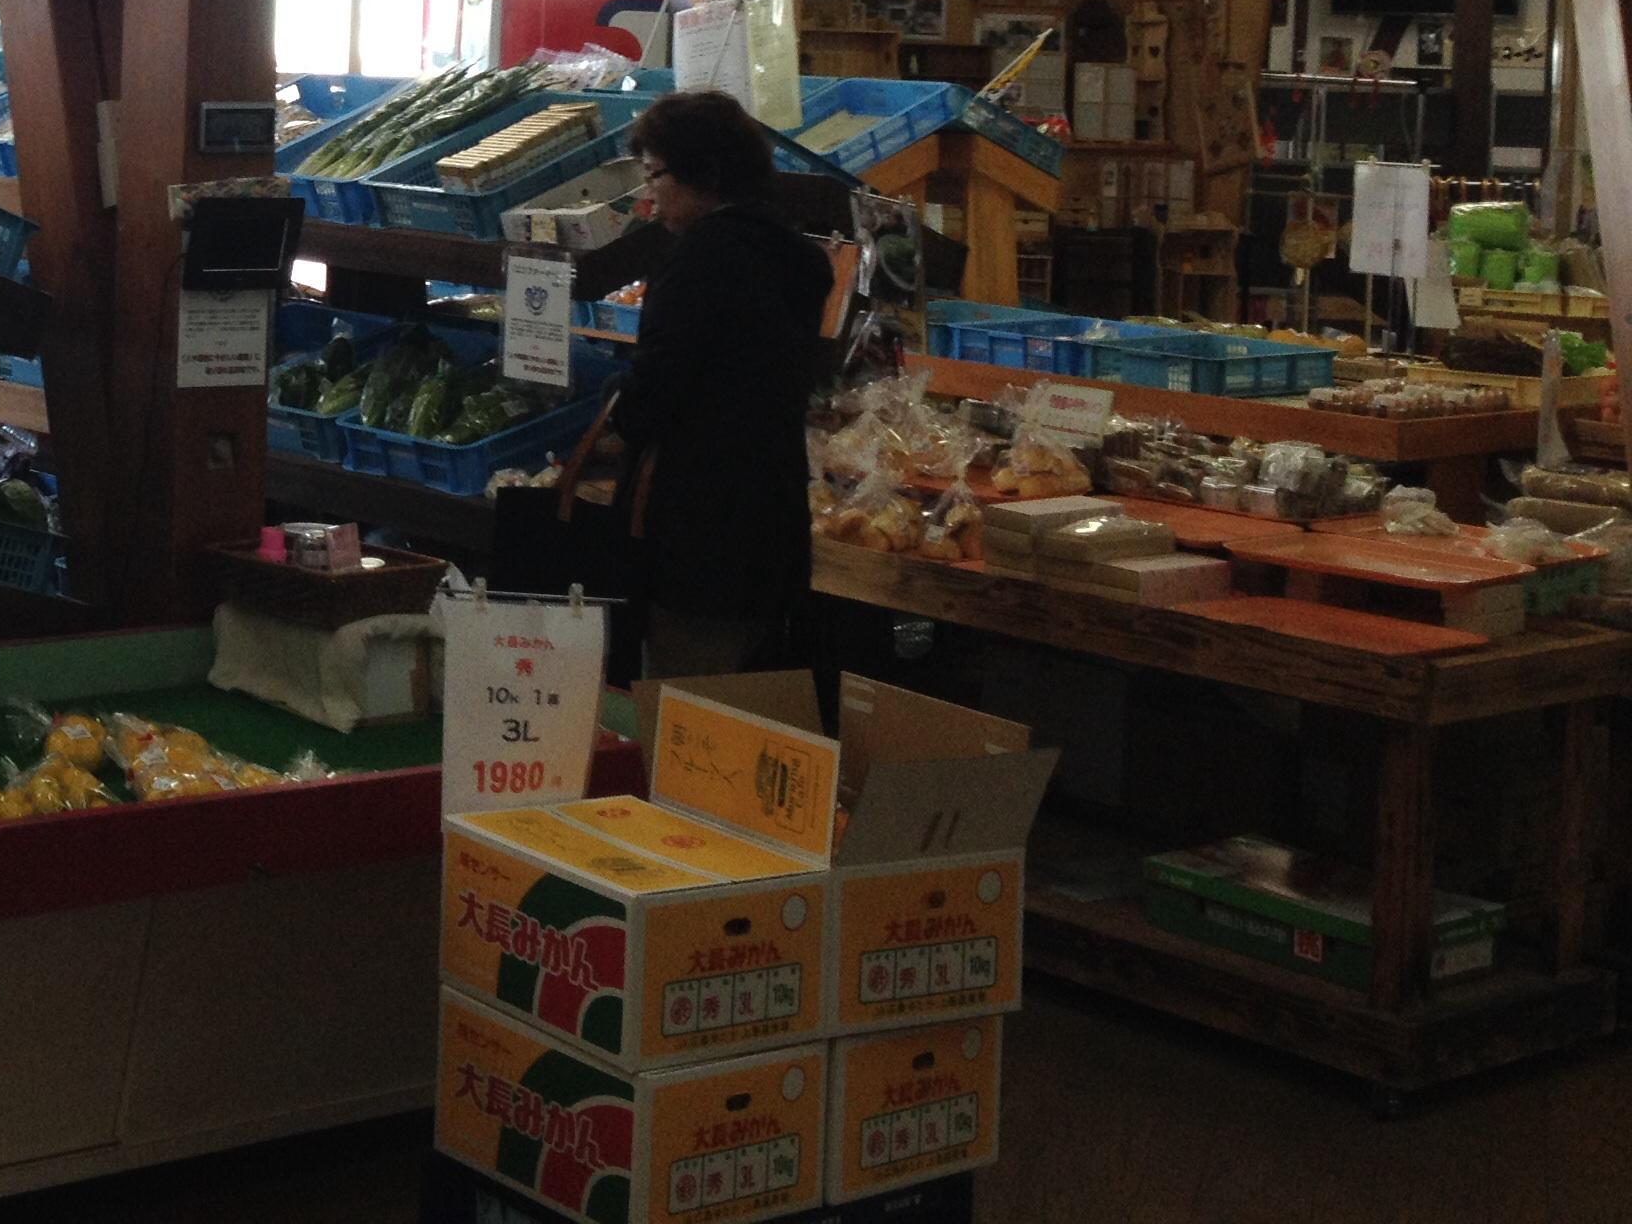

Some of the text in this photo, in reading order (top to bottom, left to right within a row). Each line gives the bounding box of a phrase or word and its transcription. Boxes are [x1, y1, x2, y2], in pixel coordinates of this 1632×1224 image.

[501, 718, 540, 743] 3L
[457, 891, 599, 993] 大長みかん
[687, 939, 782, 975] 大長みかん
[455, 1062, 607, 1172] 大長みかん
